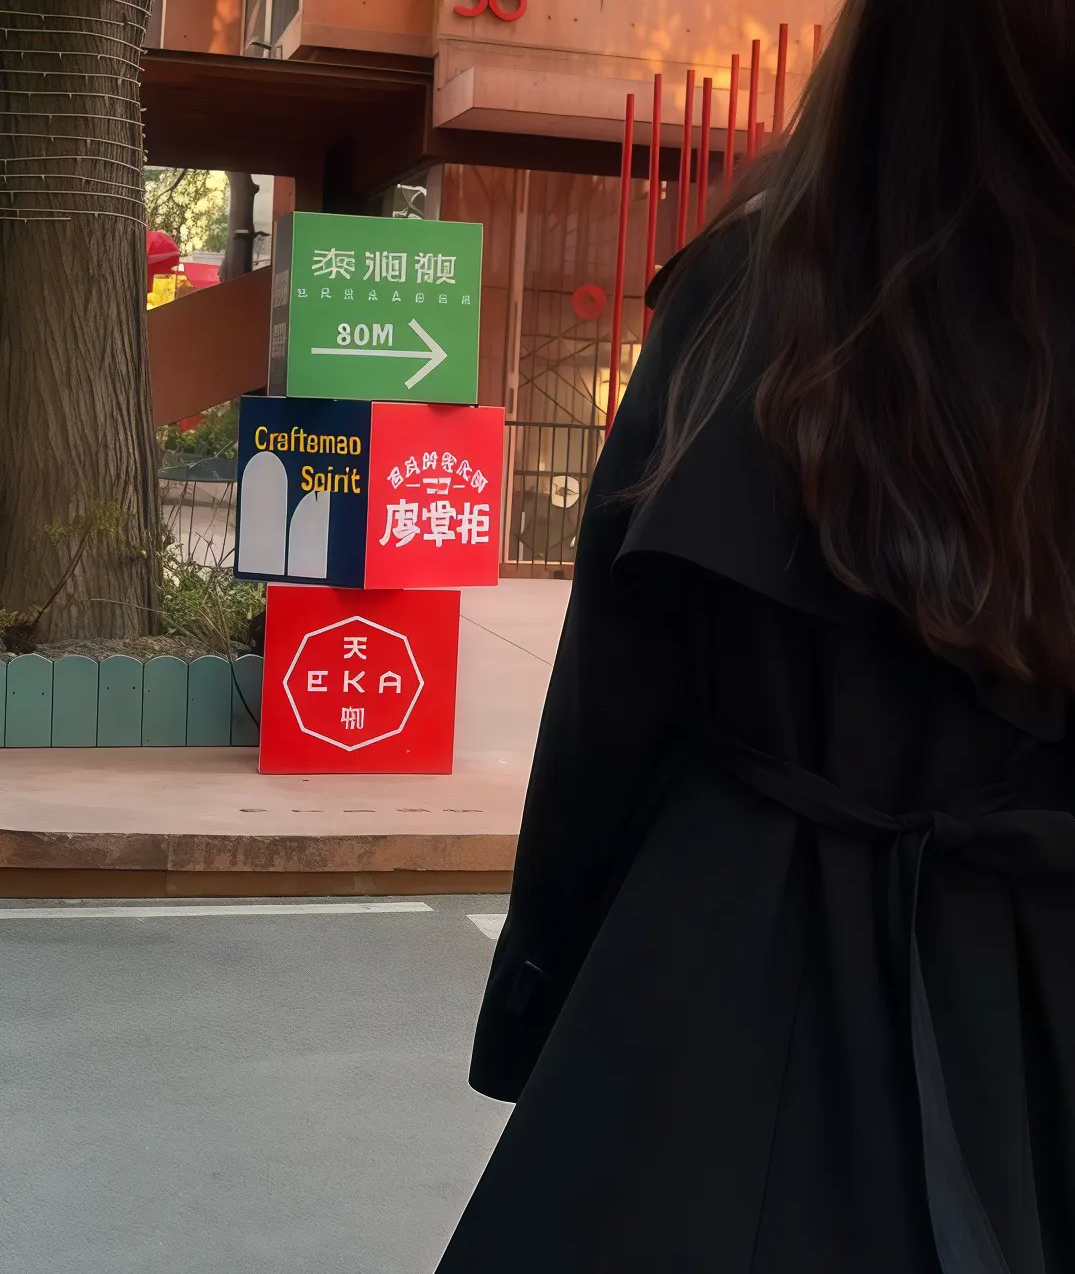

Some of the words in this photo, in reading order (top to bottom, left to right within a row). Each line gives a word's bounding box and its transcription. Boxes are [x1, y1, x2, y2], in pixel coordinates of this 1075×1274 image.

[336, 322, 394, 347] 80M
[343, 636, 368, 660] 天
[306, 670, 402, 694] EKA
